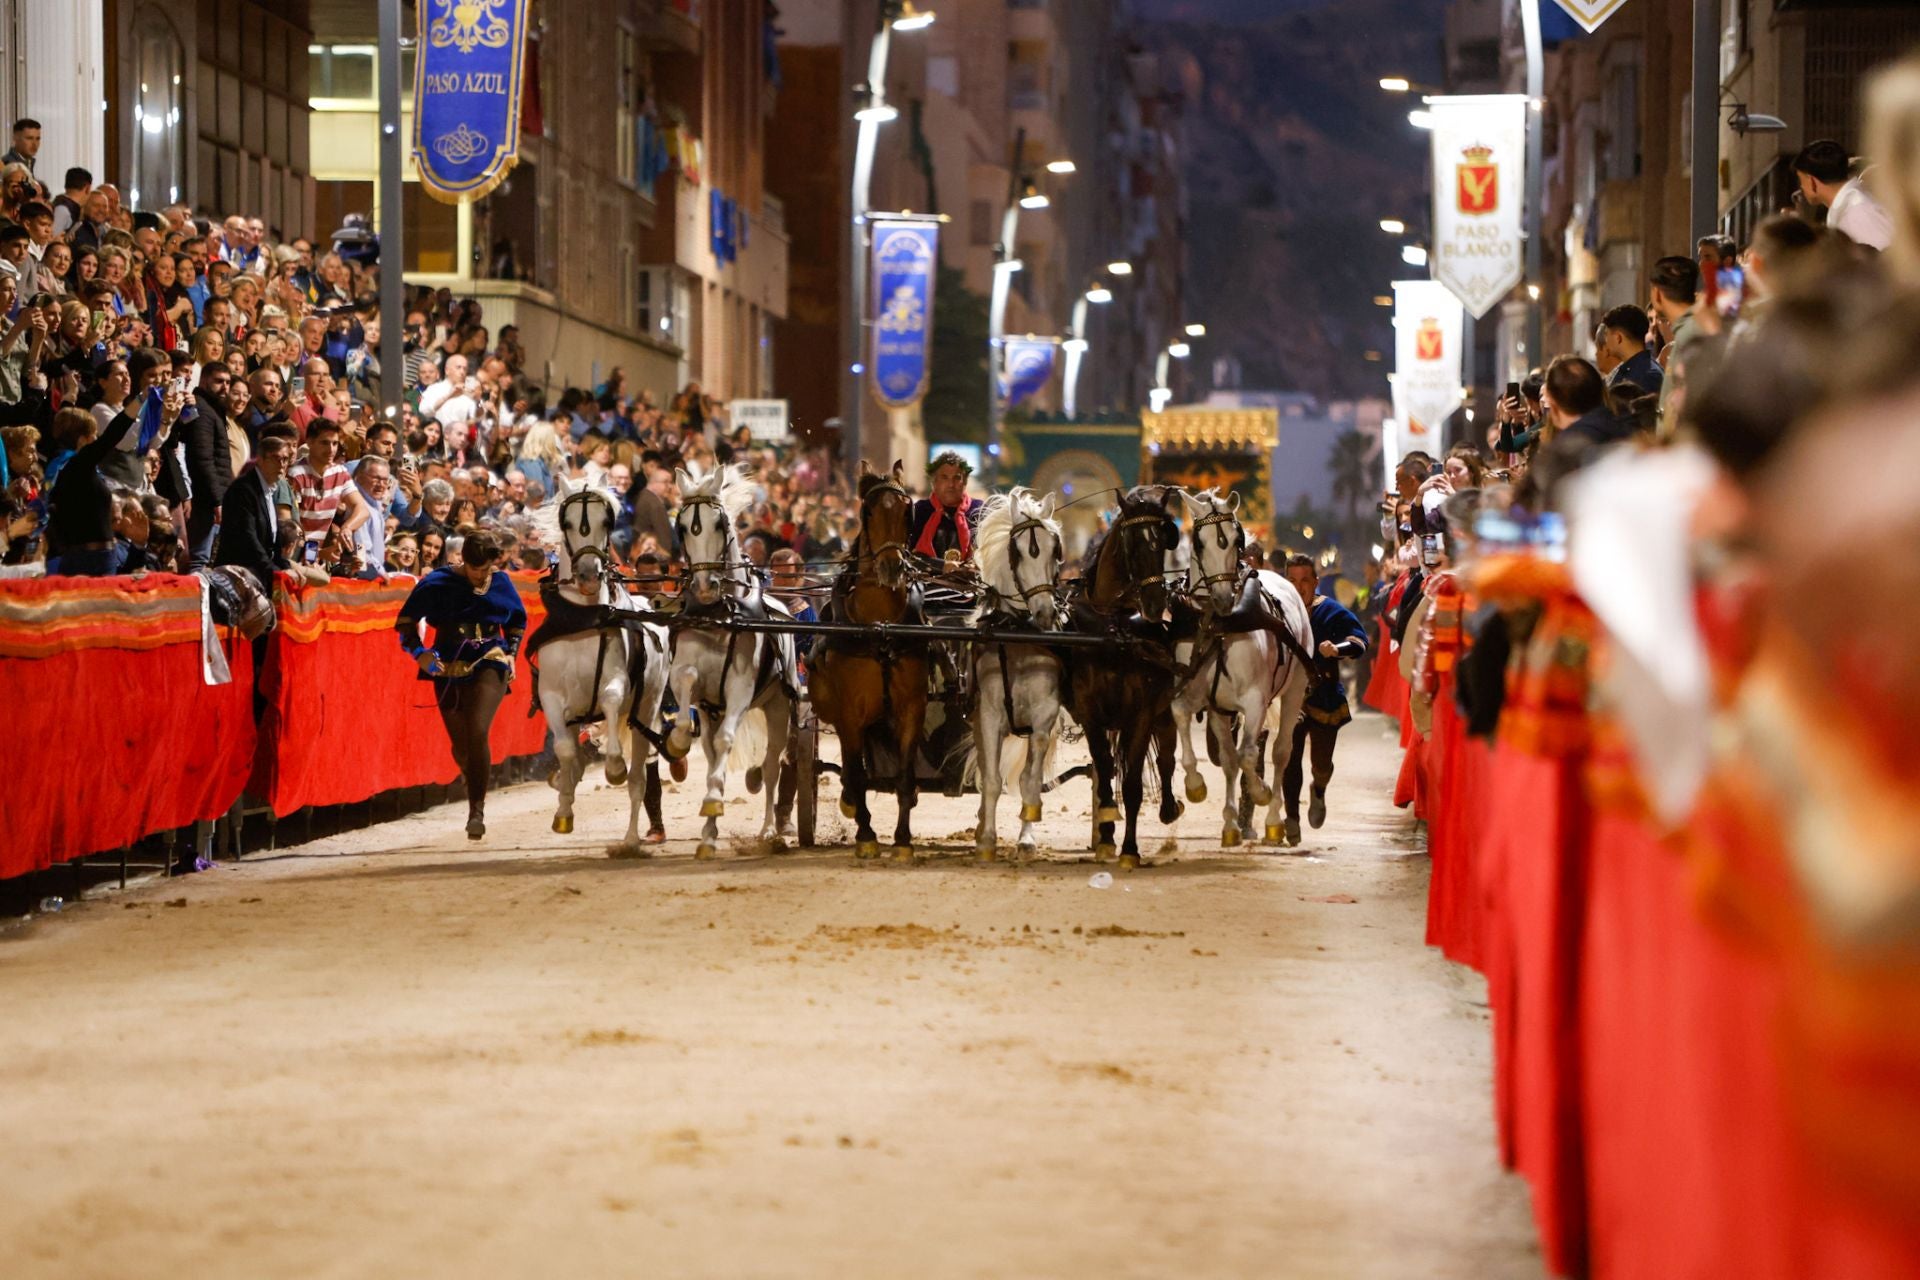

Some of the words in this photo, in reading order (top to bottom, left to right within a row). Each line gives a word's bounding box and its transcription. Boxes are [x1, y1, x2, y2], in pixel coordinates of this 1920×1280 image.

[426, 73, 460, 95] PASO
[462, 72, 506, 95] AZUL
[1455, 223, 1500, 240] PASO
[1442, 241, 1513, 258] BLANCO
